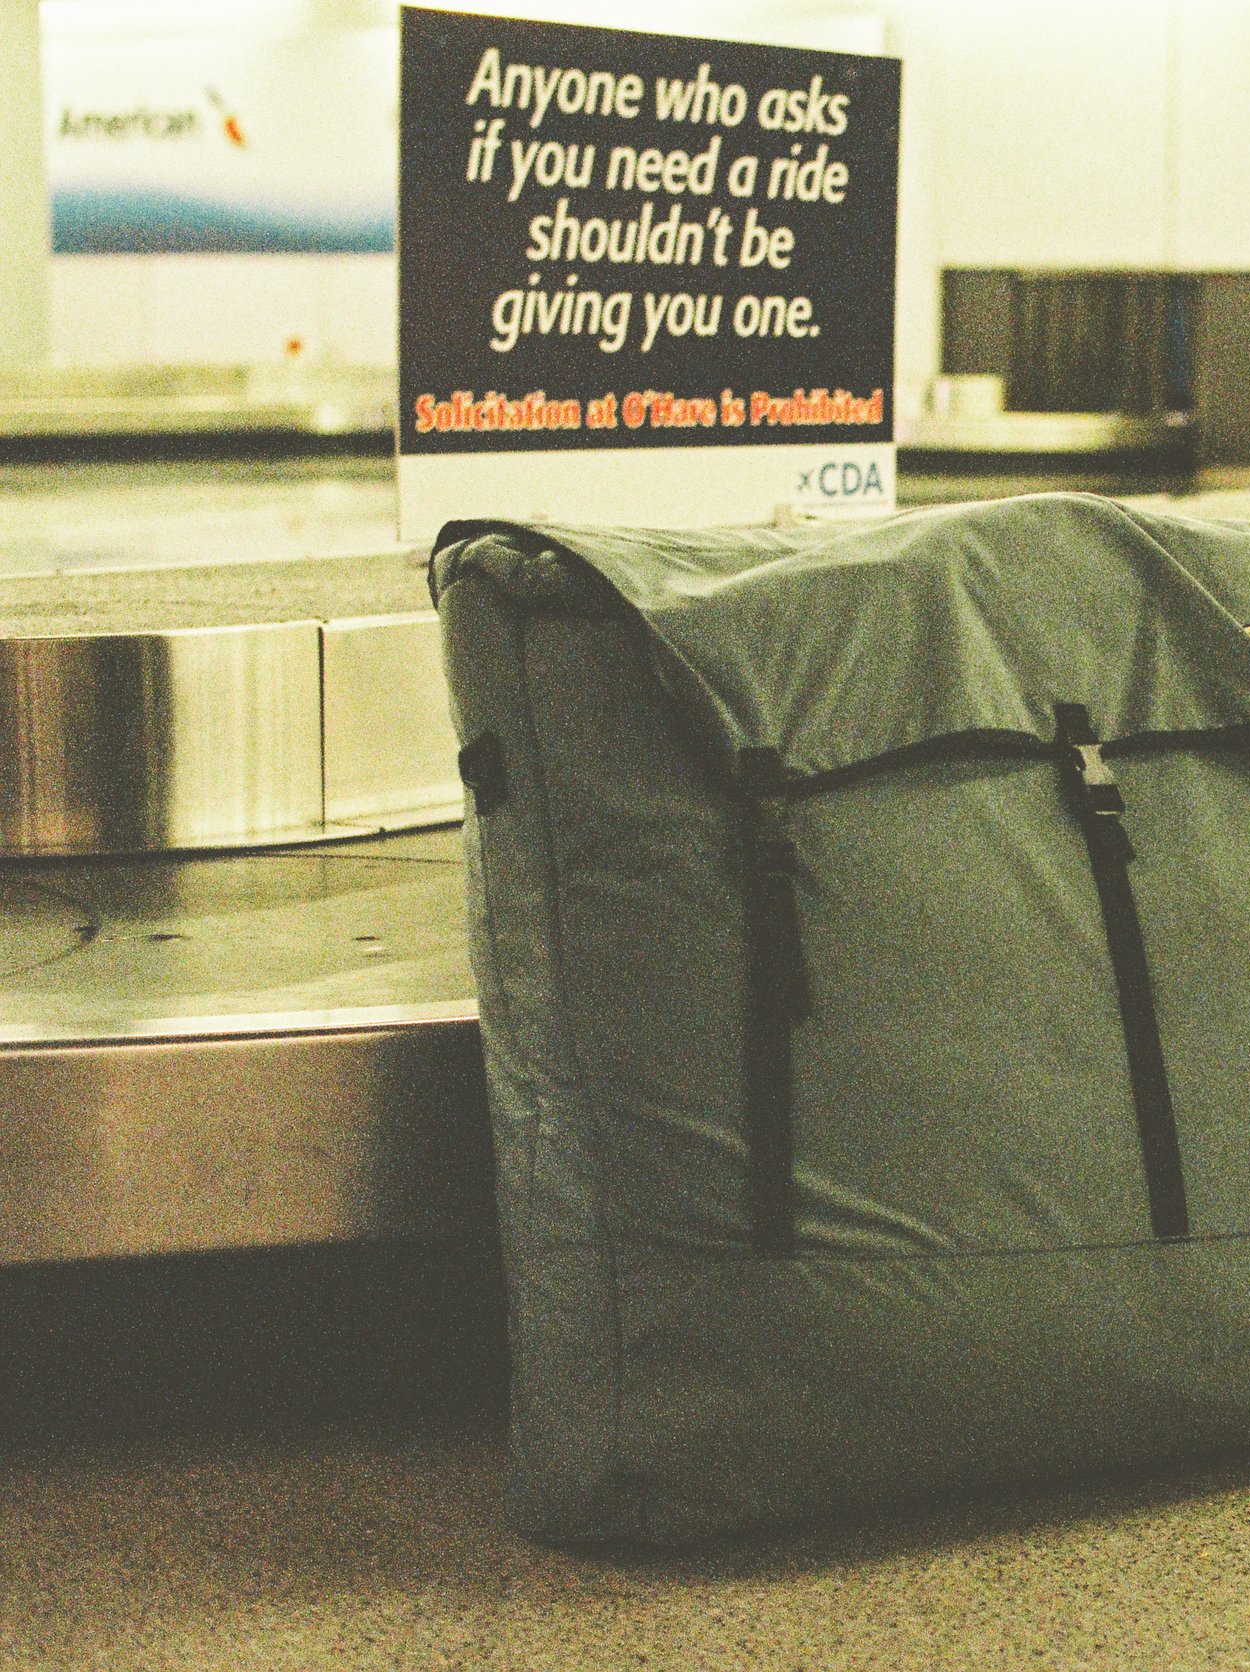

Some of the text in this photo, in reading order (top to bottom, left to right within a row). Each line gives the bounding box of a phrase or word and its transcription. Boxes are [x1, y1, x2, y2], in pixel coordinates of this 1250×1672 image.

[466, 48, 851, 136] Anyone who asks
[466, 119, 850, 204] if you need a ride
[527, 199, 796, 269] shouldn't be
[490, 274, 821, 353] giving you one.
[415, 388, 884, 433] Solicitation at O'Hare is Prohibited
[818, 462, 884, 497] CDA
